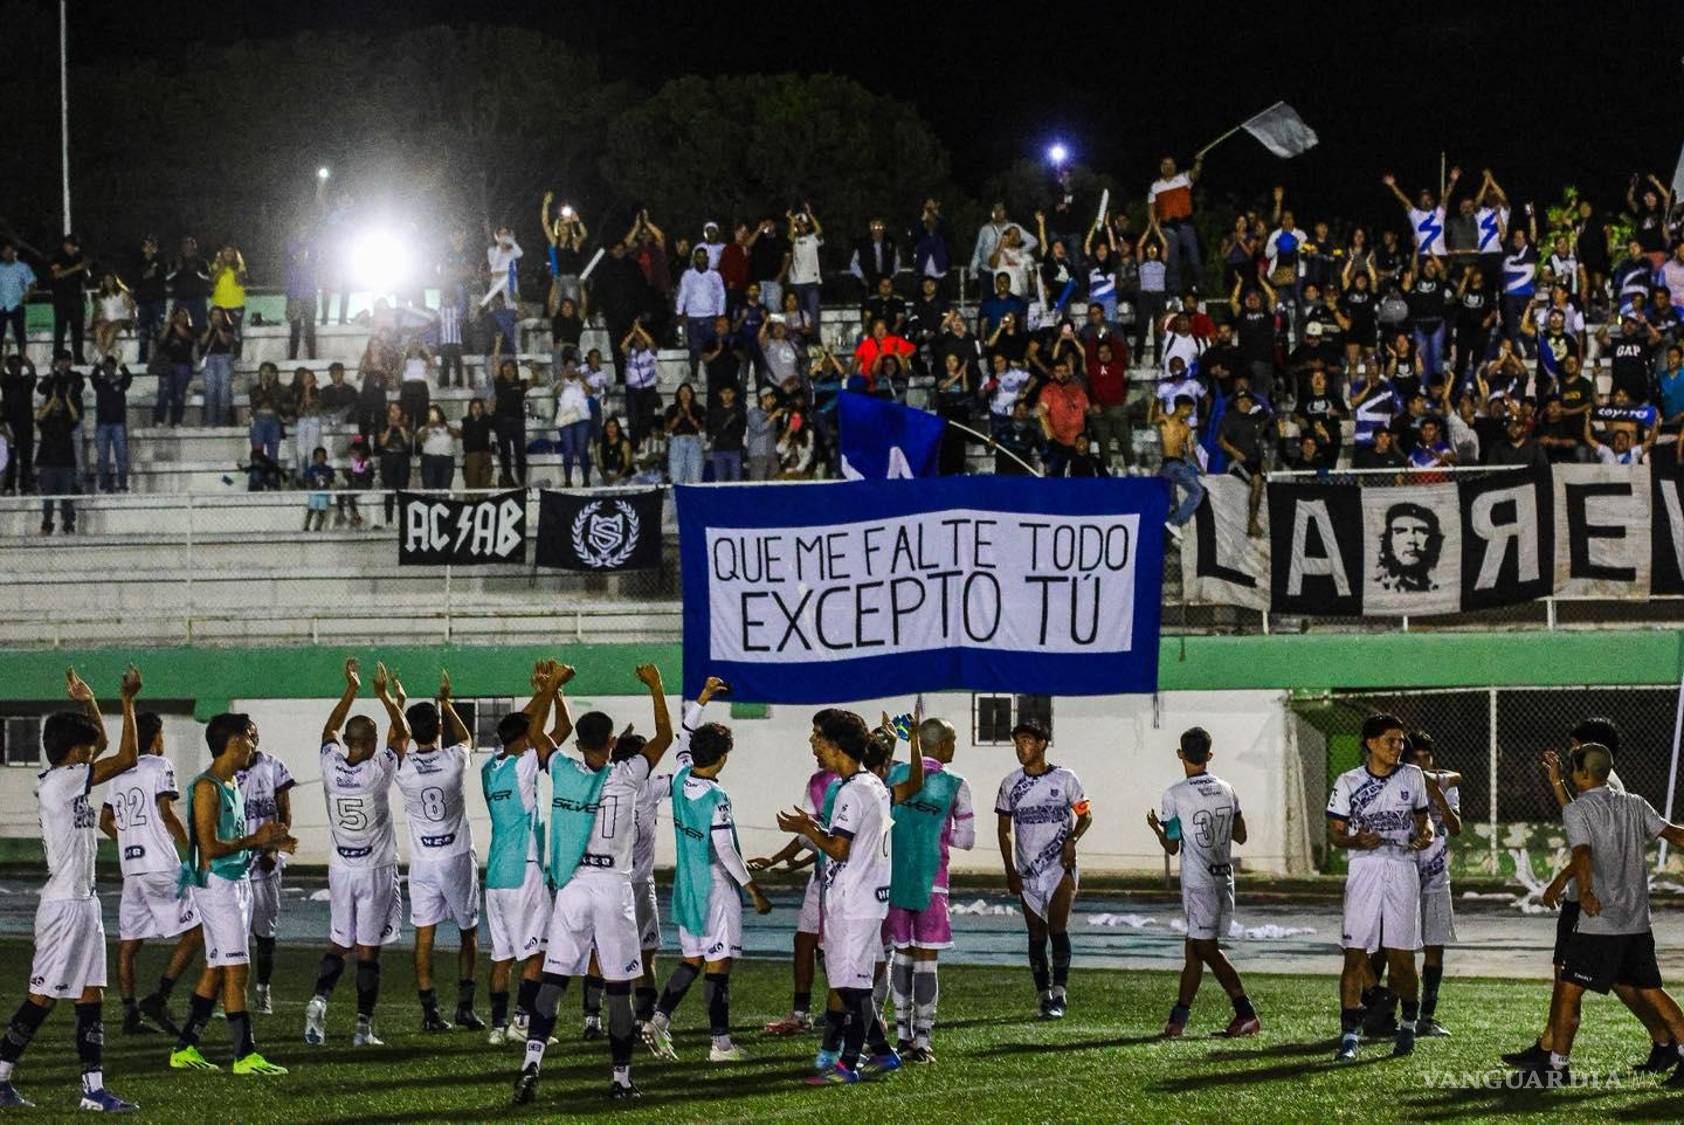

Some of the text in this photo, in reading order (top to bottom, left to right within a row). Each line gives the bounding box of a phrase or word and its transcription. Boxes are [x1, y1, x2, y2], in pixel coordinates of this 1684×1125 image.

[1616, 344, 1641, 357] GAP
[713, 519, 1129, 583] QUE ME FALTE TODO
[741, 570, 1101, 652] EXCEPTO TÚ
[112, 786, 147, 831] 32
[337, 798, 368, 831] 5
[420, 786, 447, 822] 8
[600, 795, 618, 838] 1
[1193, 806, 1233, 848] 37
